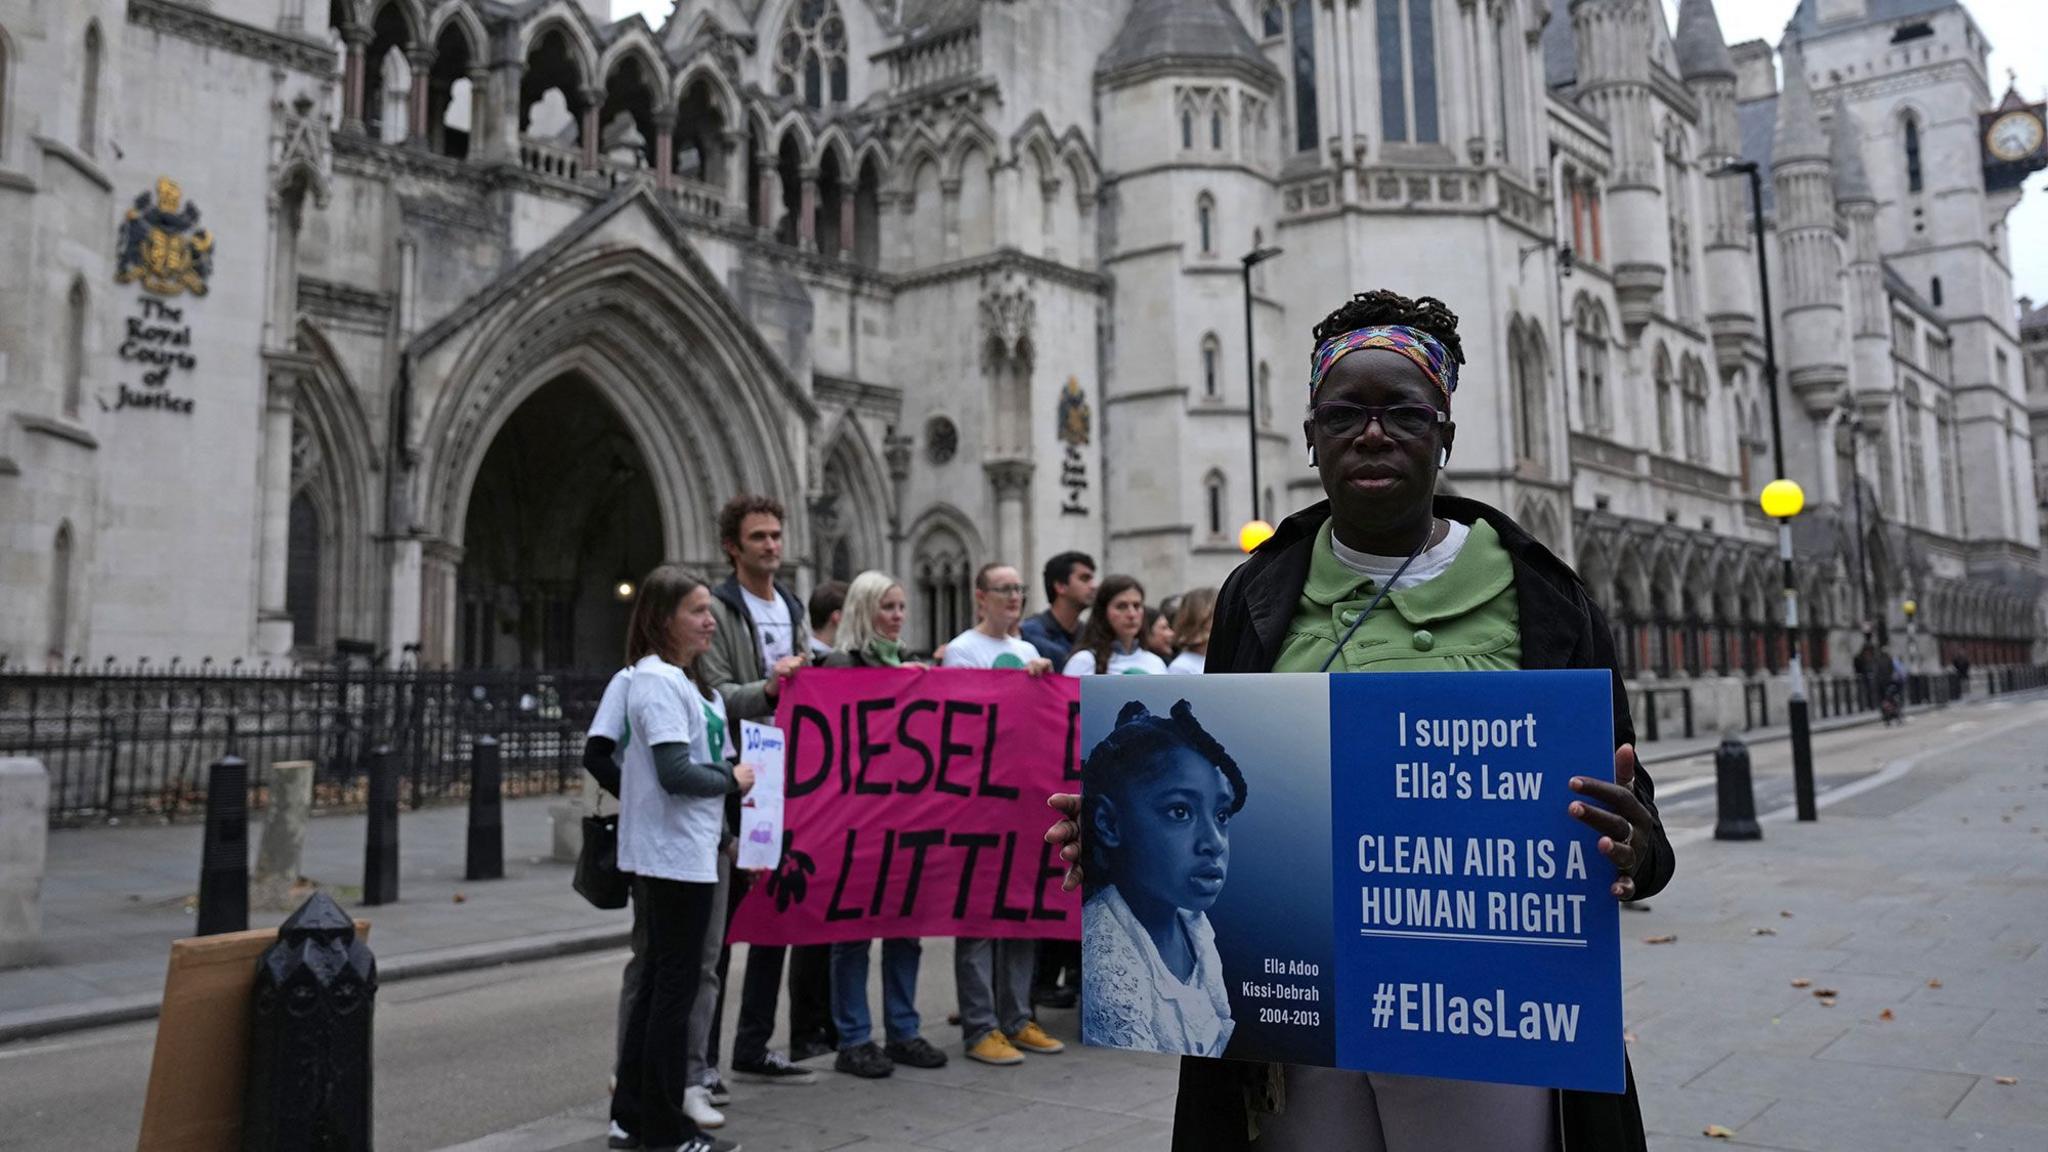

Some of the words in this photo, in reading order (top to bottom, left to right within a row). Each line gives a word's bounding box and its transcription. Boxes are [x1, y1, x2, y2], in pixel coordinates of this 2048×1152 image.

[137, 297, 182, 322] The
[126, 316, 191, 346] Royal
[119, 340, 196, 370] Courts
[143, 365, 171, 387] of
[114, 382, 195, 414] Justice
[745, 727, 762, 750] 10
[784, 697, 1020, 800] DIESEL
[1399, 712, 1406, 747] I
[1415, 713, 1537, 756] support
[1395, 762, 1472, 800] Ella's
[1481, 764, 1543, 801] Law
[1358, 834, 1453, 876] CLEAN
[1463, 838, 1516, 878] AIR
[1526, 839, 1556, 880] IS
[1565, 840, 1588, 880] A
[824, 828, 1067, 922] LITTLE
[1361, 886, 1476, 929] HUMAN
[1488, 891, 1587, 934] RIGHT
[1264, 958, 1286, 974] Ella
[1288, 960, 1319, 977] Adoo
[1242, 981, 1320, 1002] Kissi-Debrah
[1259, 1007, 1320, 1027] 2004-2013
[1371, 982, 1580, 1042] #EllasLaw
